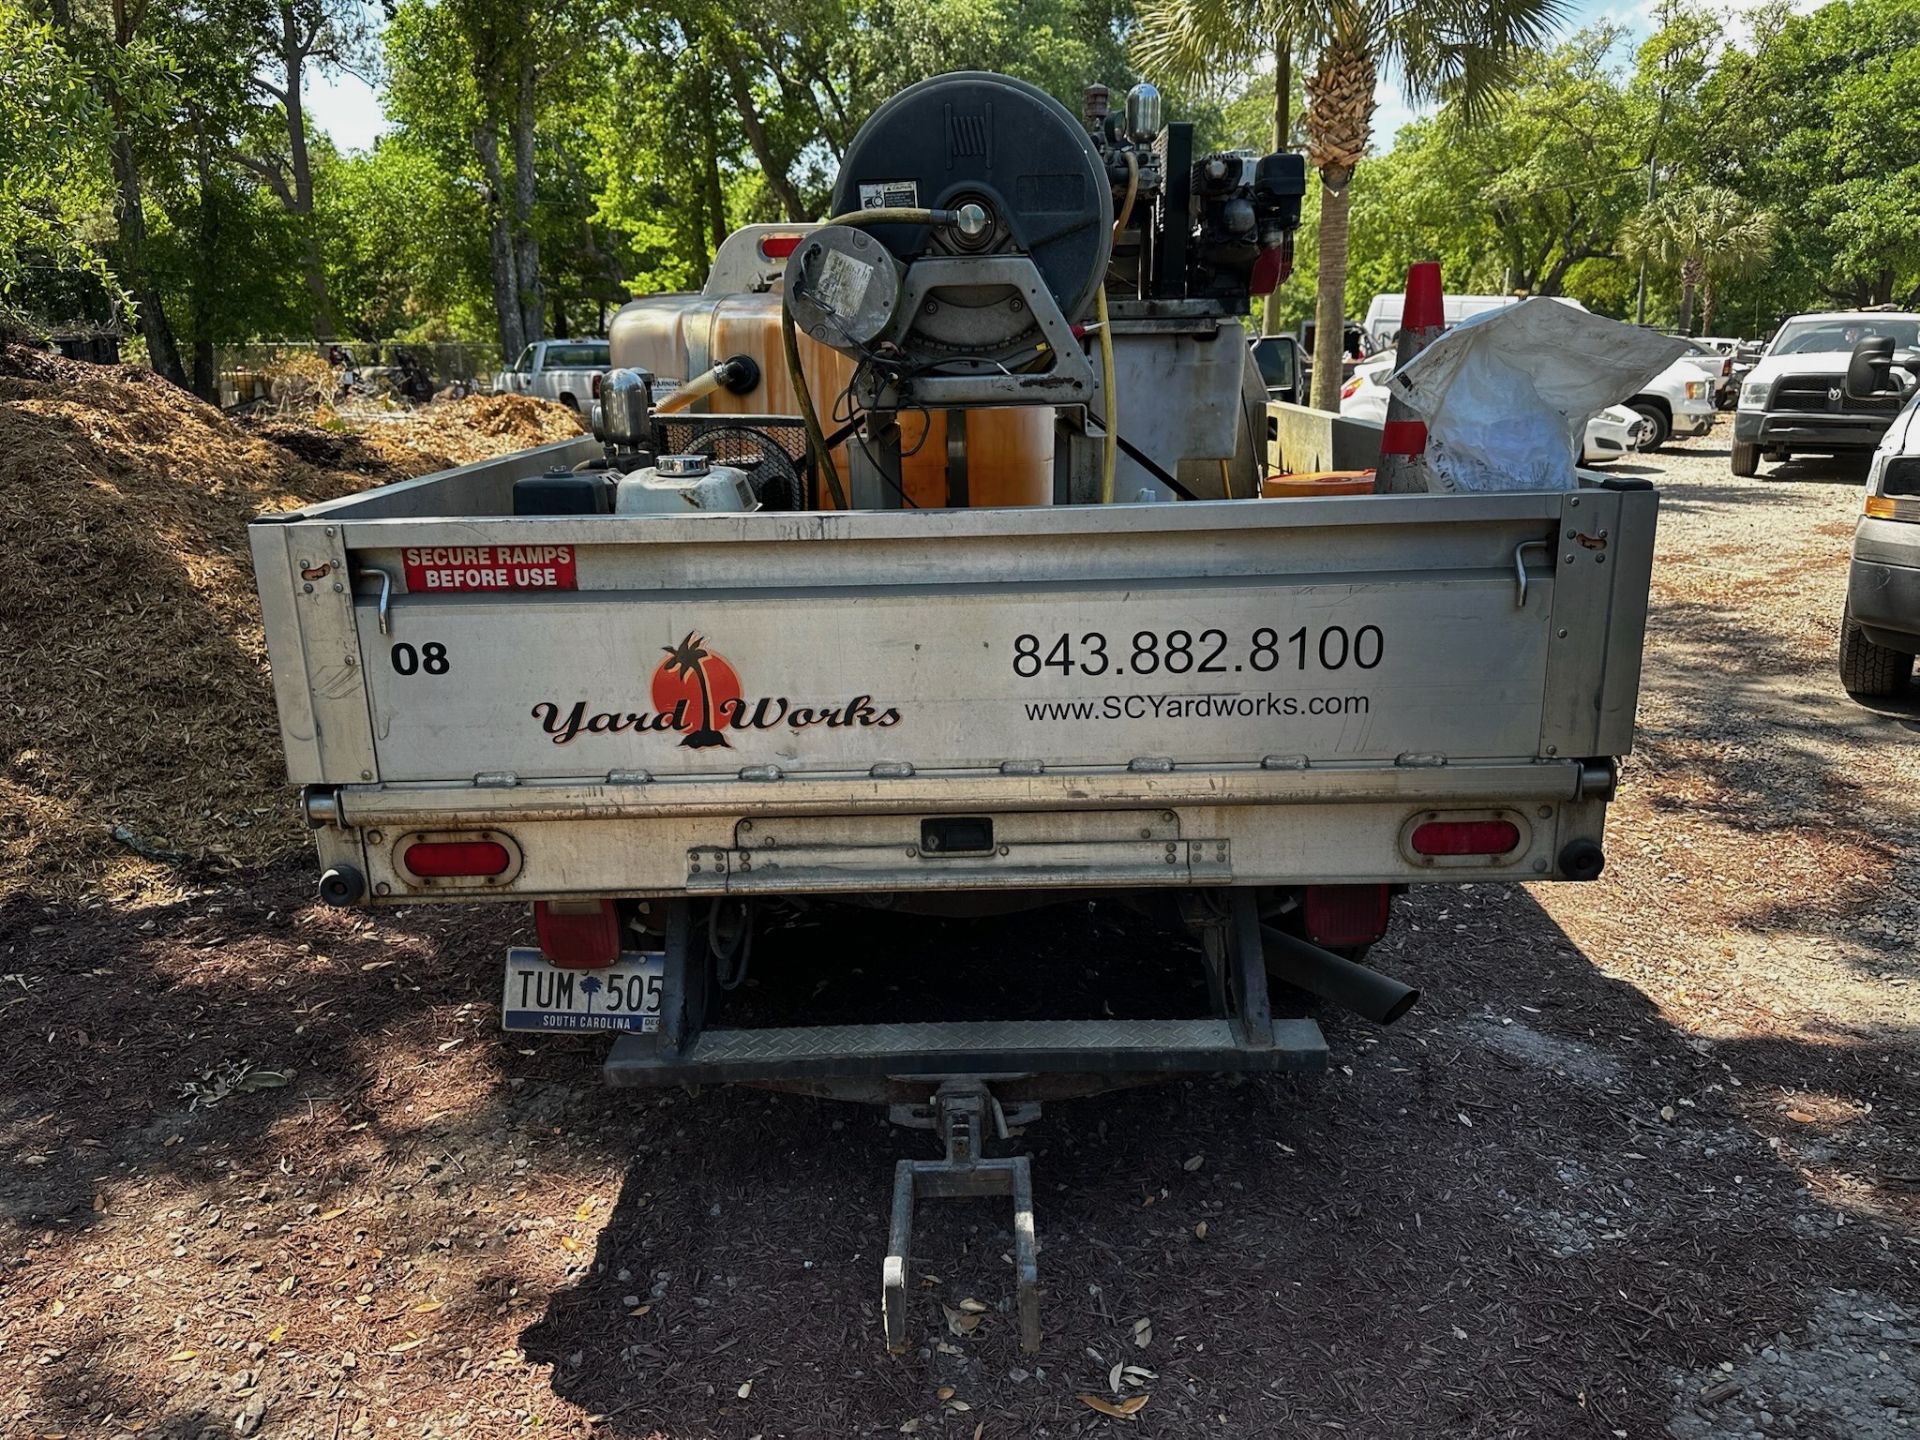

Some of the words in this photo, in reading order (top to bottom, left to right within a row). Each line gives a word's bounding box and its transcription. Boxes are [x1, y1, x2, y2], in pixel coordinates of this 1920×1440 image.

[407, 548, 491, 566] SECURE
[497, 546, 571, 565] RAMPS
[425, 569, 509, 587] BEFORE
[515, 568, 557, 586] USE
[390, 642, 450, 676] 08
[1012, 625, 1384, 677] 843.882.8100
[531, 698, 692, 744] Yard
[719, 695, 902, 730] Works
[1025, 693, 1369, 721] www.SCYardworks.com
[518, 971, 575, 1010] TUM
[606, 974, 664, 1012] 505
[543, 1015, 576, 1027] SOUTH
[580, 1016, 631, 1030] CAROLINA
